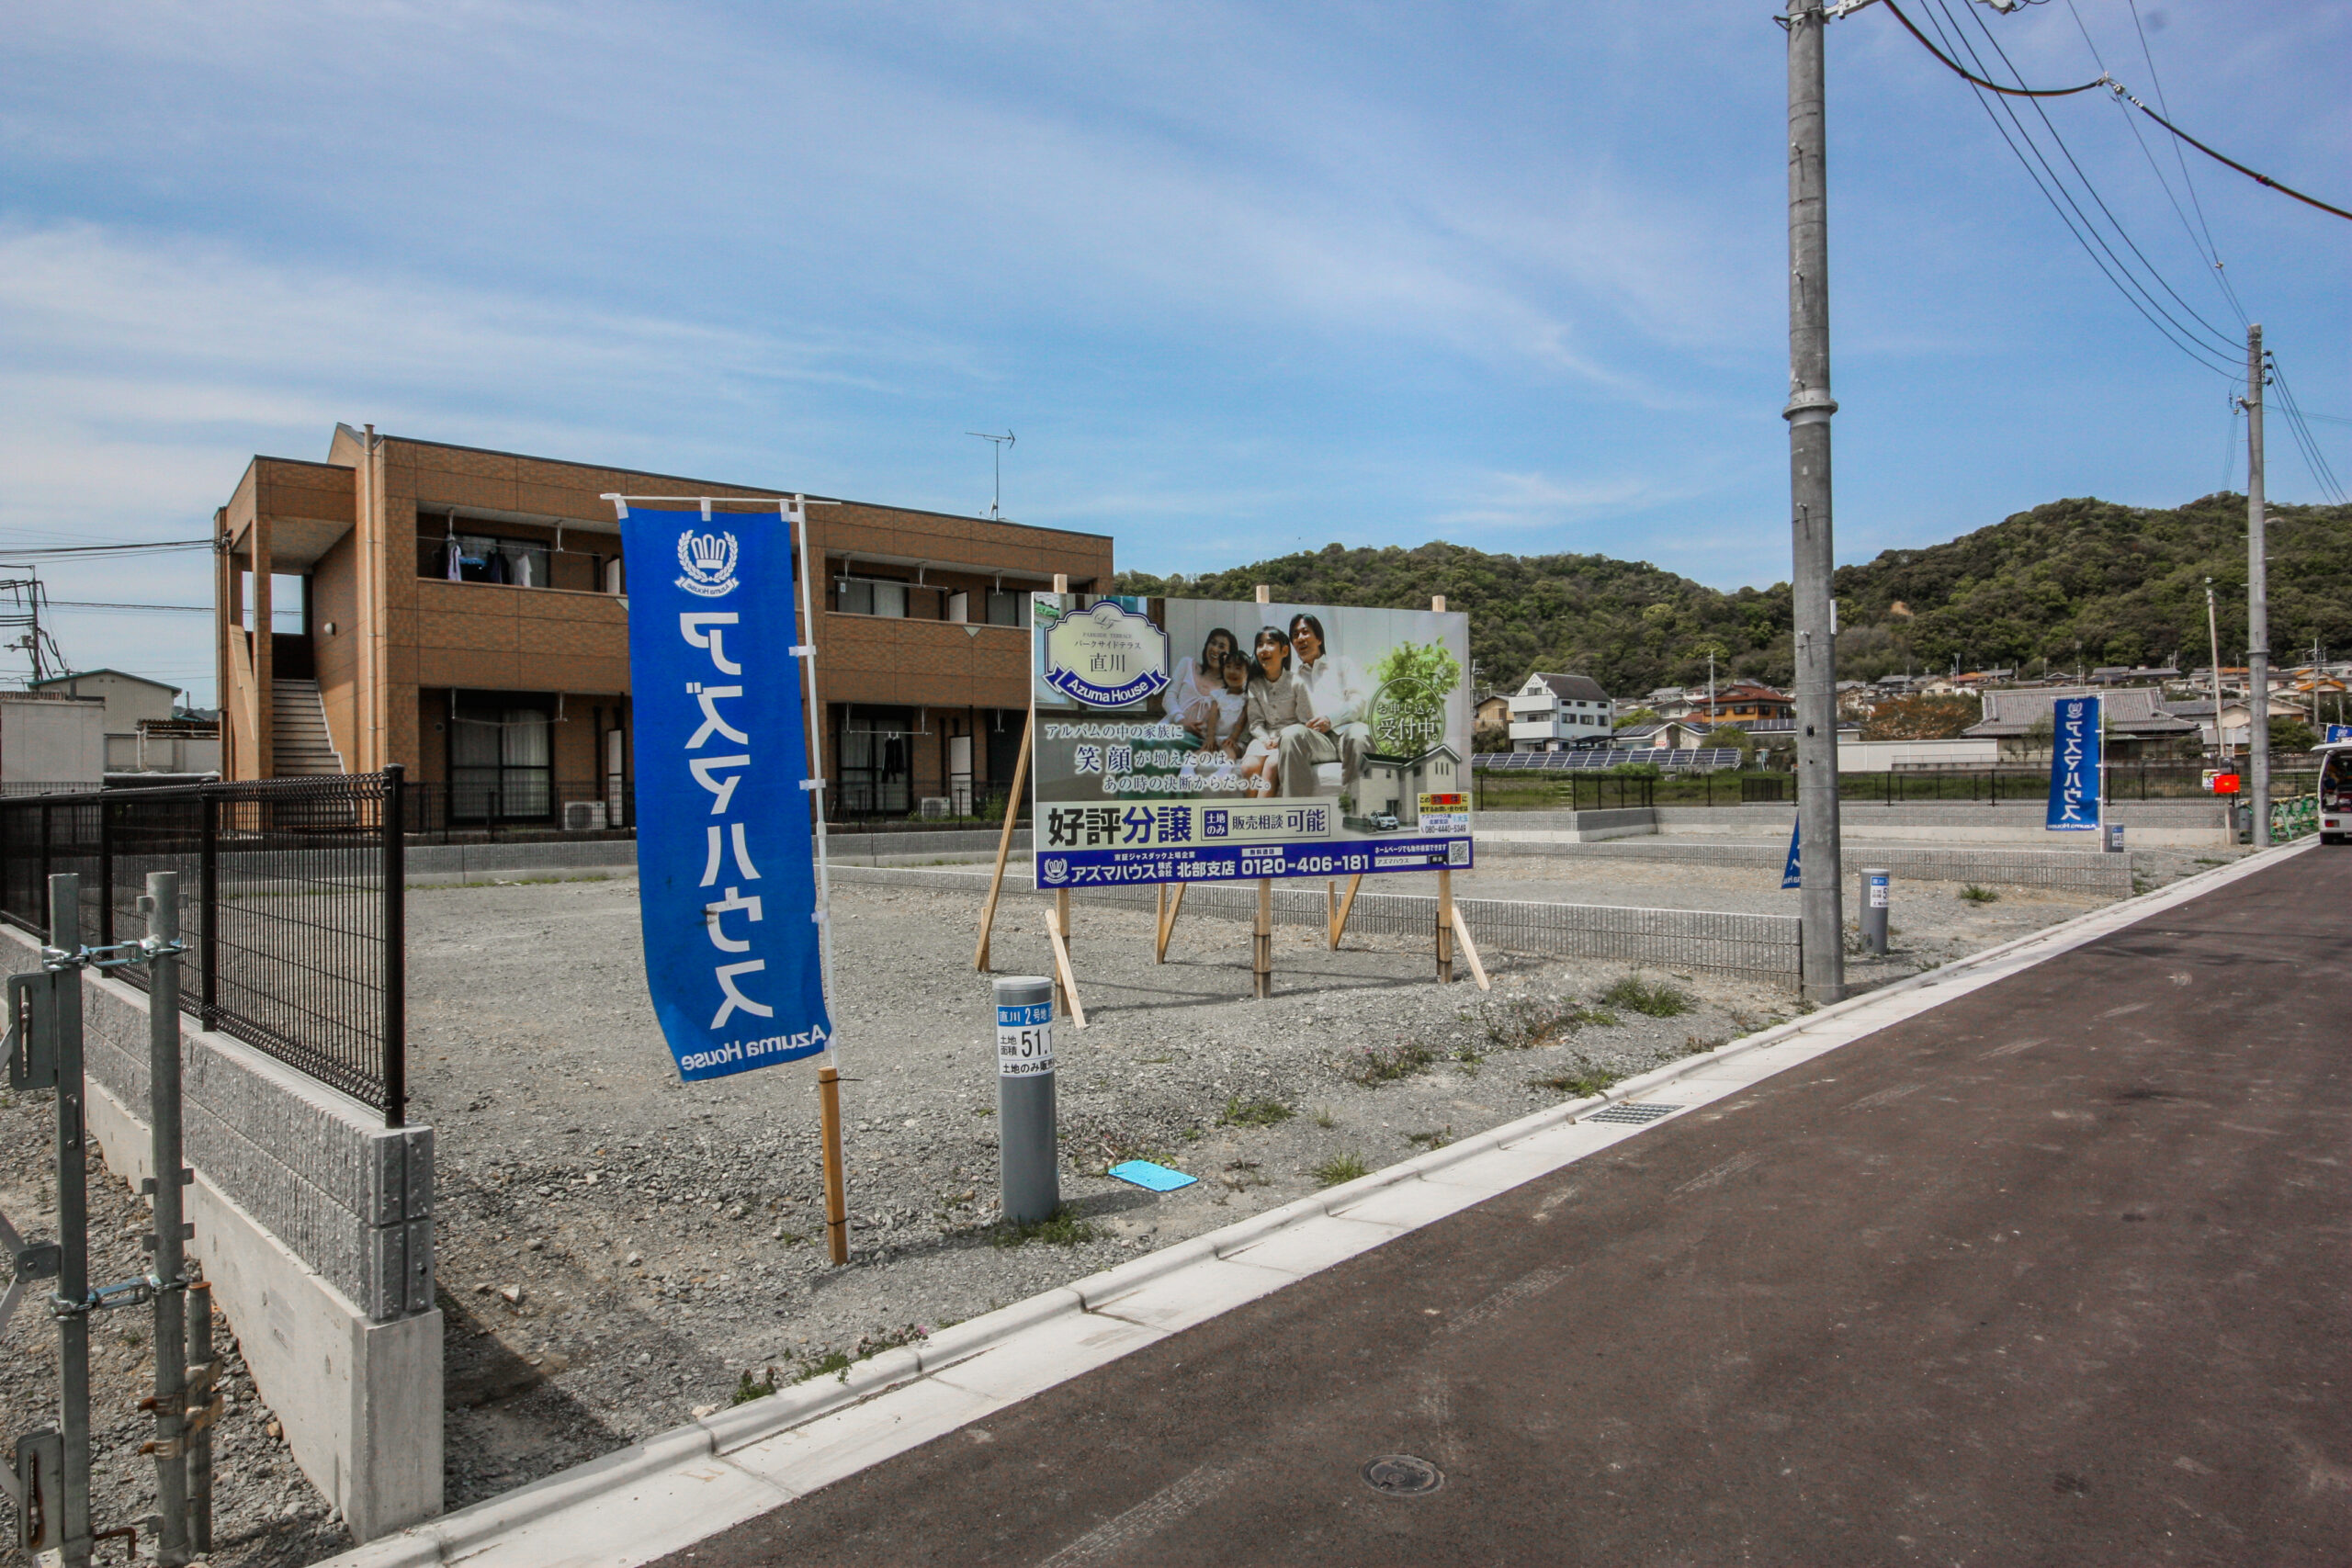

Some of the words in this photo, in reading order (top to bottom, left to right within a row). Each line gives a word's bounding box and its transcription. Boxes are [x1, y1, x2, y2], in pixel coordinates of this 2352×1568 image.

[1074, 640, 1141, 649] パークサイドテラス
[1090, 653, 1125, 672] 直川
[1067, 679, 1110, 703] Azuma
[1112, 681, 1148, 703] House
[1378, 703, 1437, 714] お申し込み
[1046, 724, 1183, 739] アルバムの中の家族に
[1377, 717, 1438, 740] 受付中。
[1103, 775, 1272, 791] あの時の決断からだった。
[1048, 806, 1192, 847] 好評分譲
[1206, 813, 1226, 824] 土地
[1206, 825, 1226, 835] のみ
[1177, 860, 1236, 878] 北部支店
[1242, 854, 1369, 875] 0120-406-181
[1071, 863, 1157, 883] アズマハウス
[999, 1010, 1021, 1022] 直川
[1000, 1035, 1017, 1045] 土地
